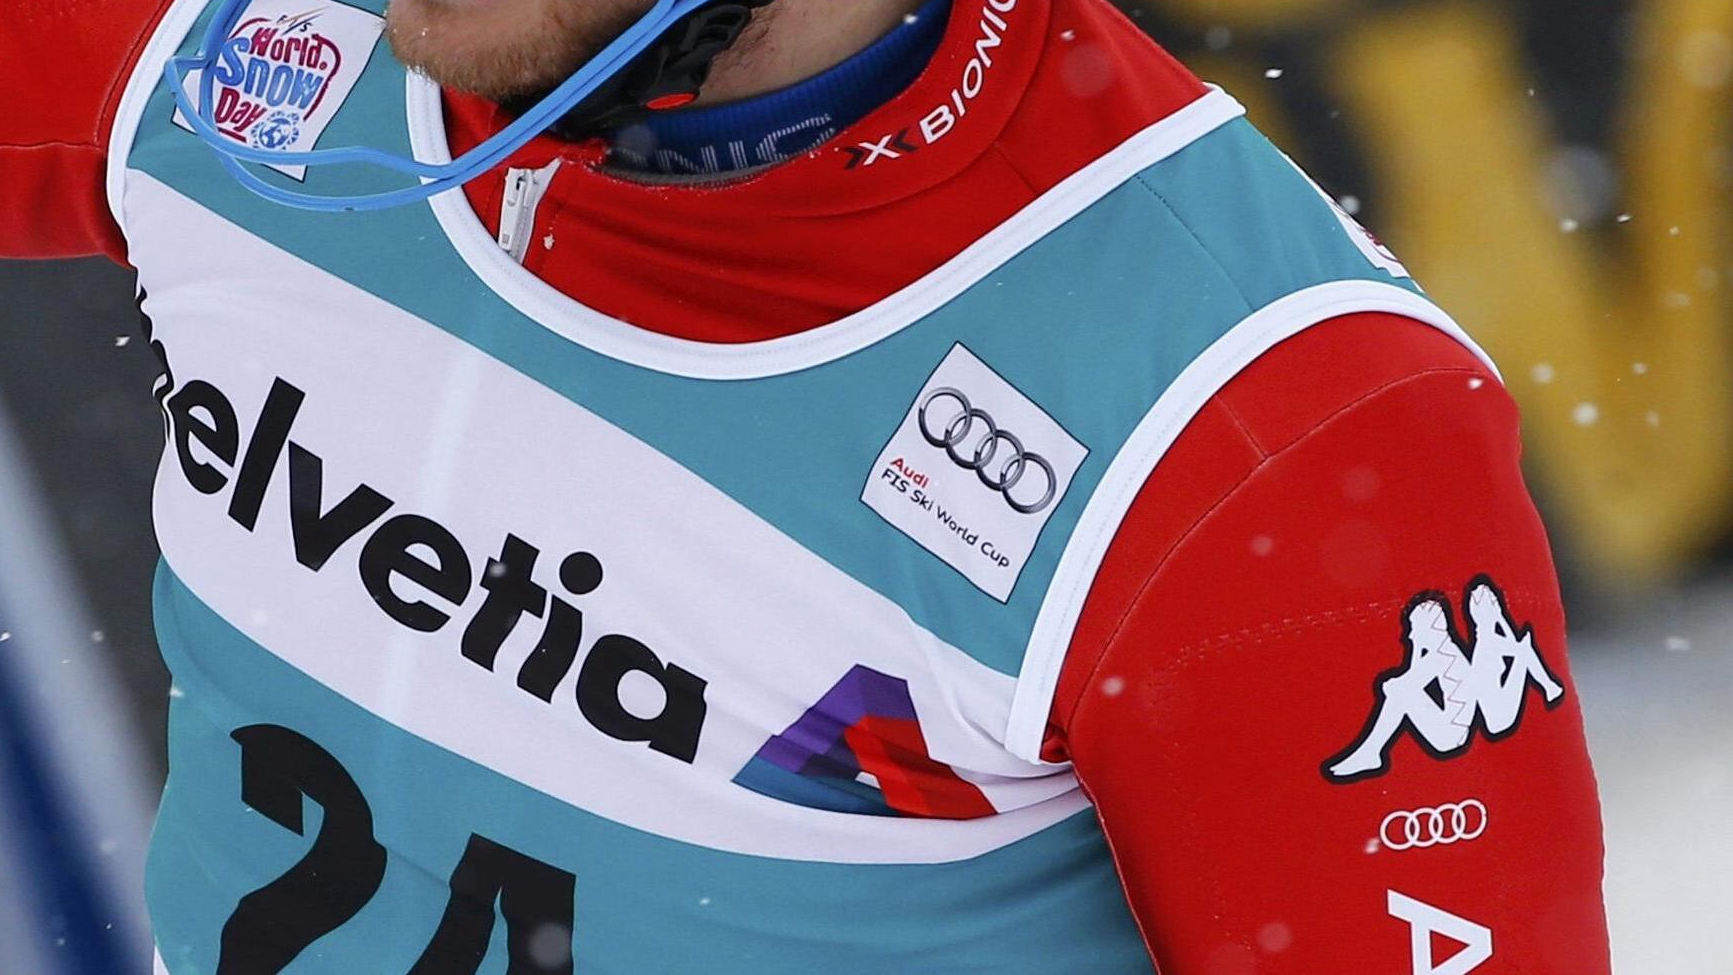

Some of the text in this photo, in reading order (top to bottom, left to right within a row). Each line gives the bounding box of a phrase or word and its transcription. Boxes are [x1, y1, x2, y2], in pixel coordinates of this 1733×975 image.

[249, 26, 324, 69] World
[214, 86, 268, 132] Day
[889, 456, 930, 489] Audi
[880, 467, 1010, 569] FIS Ski World Cup
[148, 326, 708, 765] elvetia
